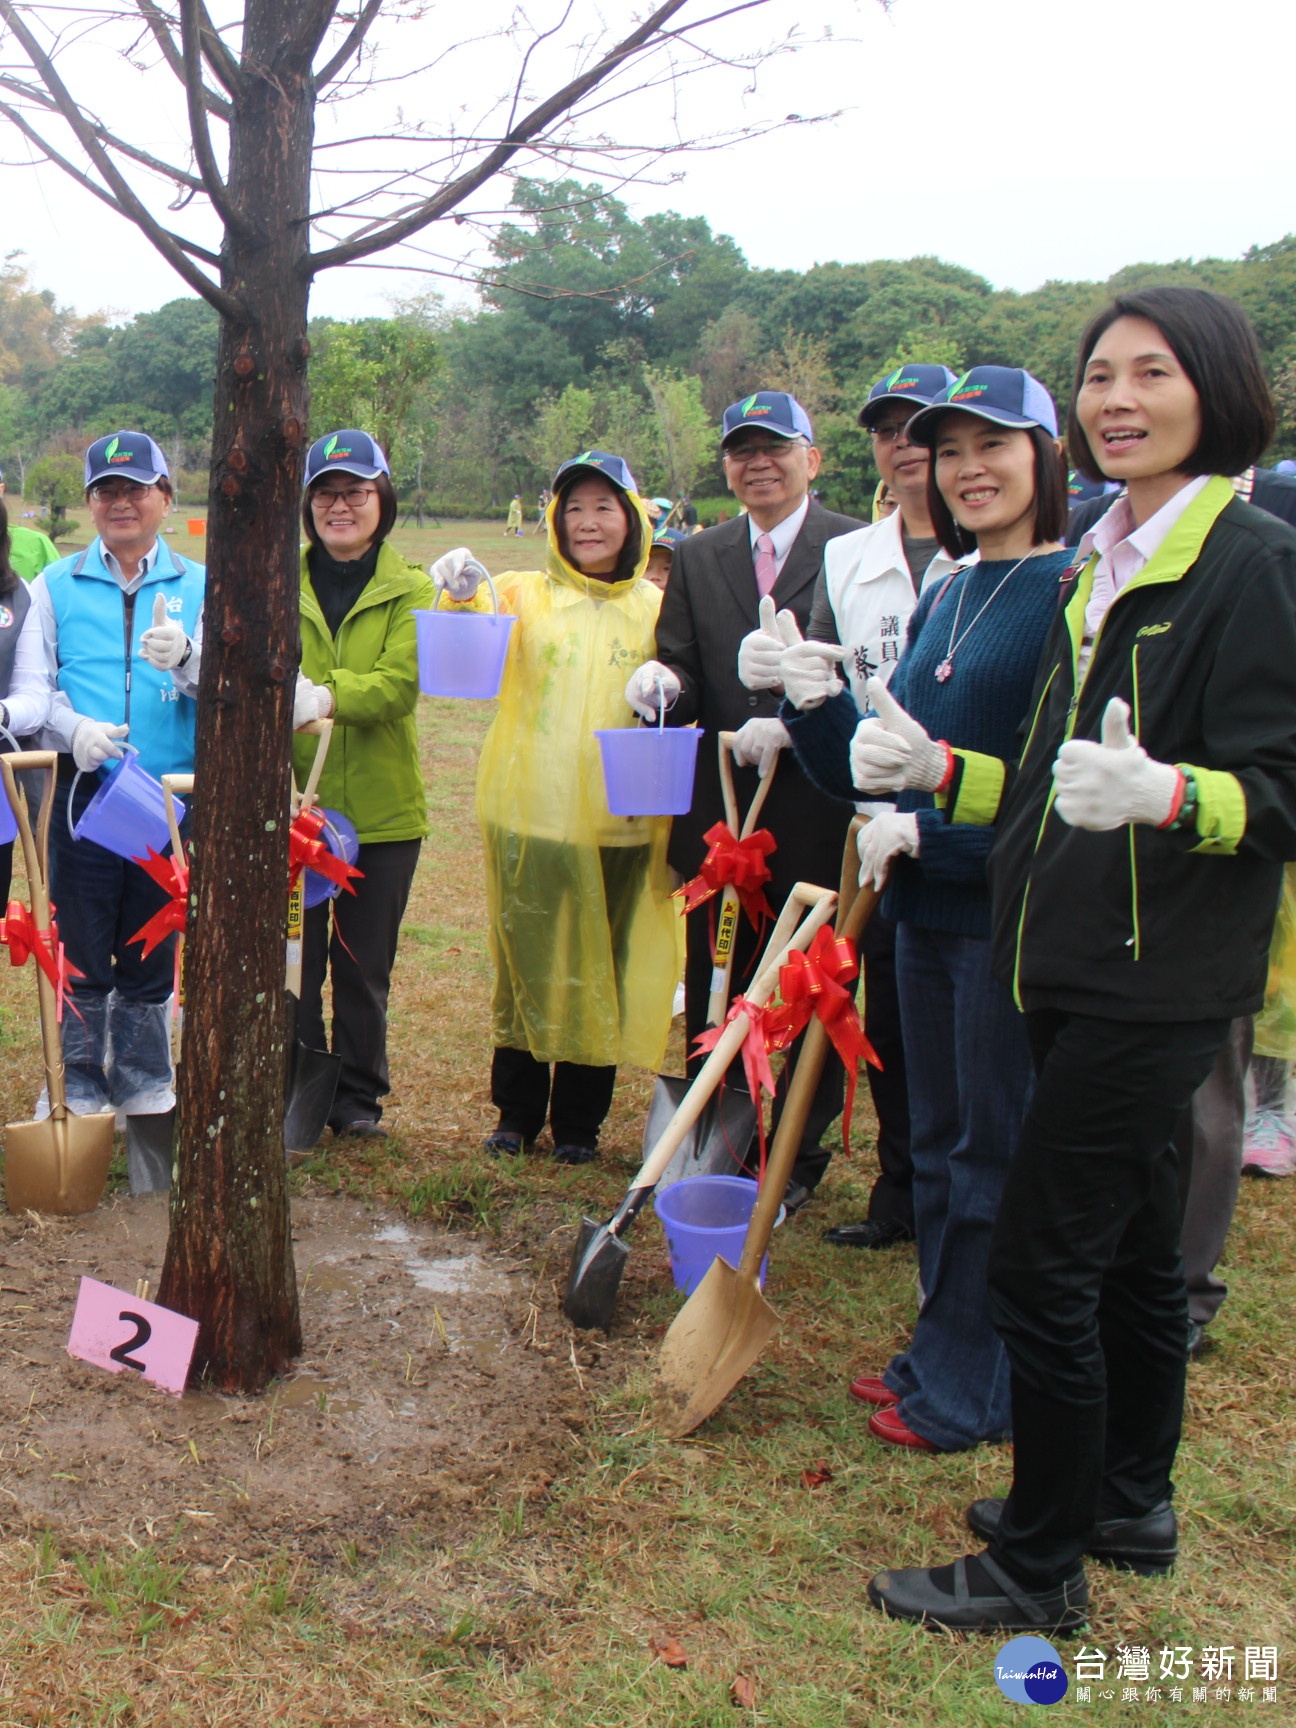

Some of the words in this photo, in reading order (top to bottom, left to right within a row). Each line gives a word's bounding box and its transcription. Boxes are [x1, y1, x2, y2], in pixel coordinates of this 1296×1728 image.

[880, 615, 899, 664] 議員
[289, 891, 300, 922] 百代印
[718, 916, 733, 949] 百代印
[110, 1311, 152, 1373] 2
